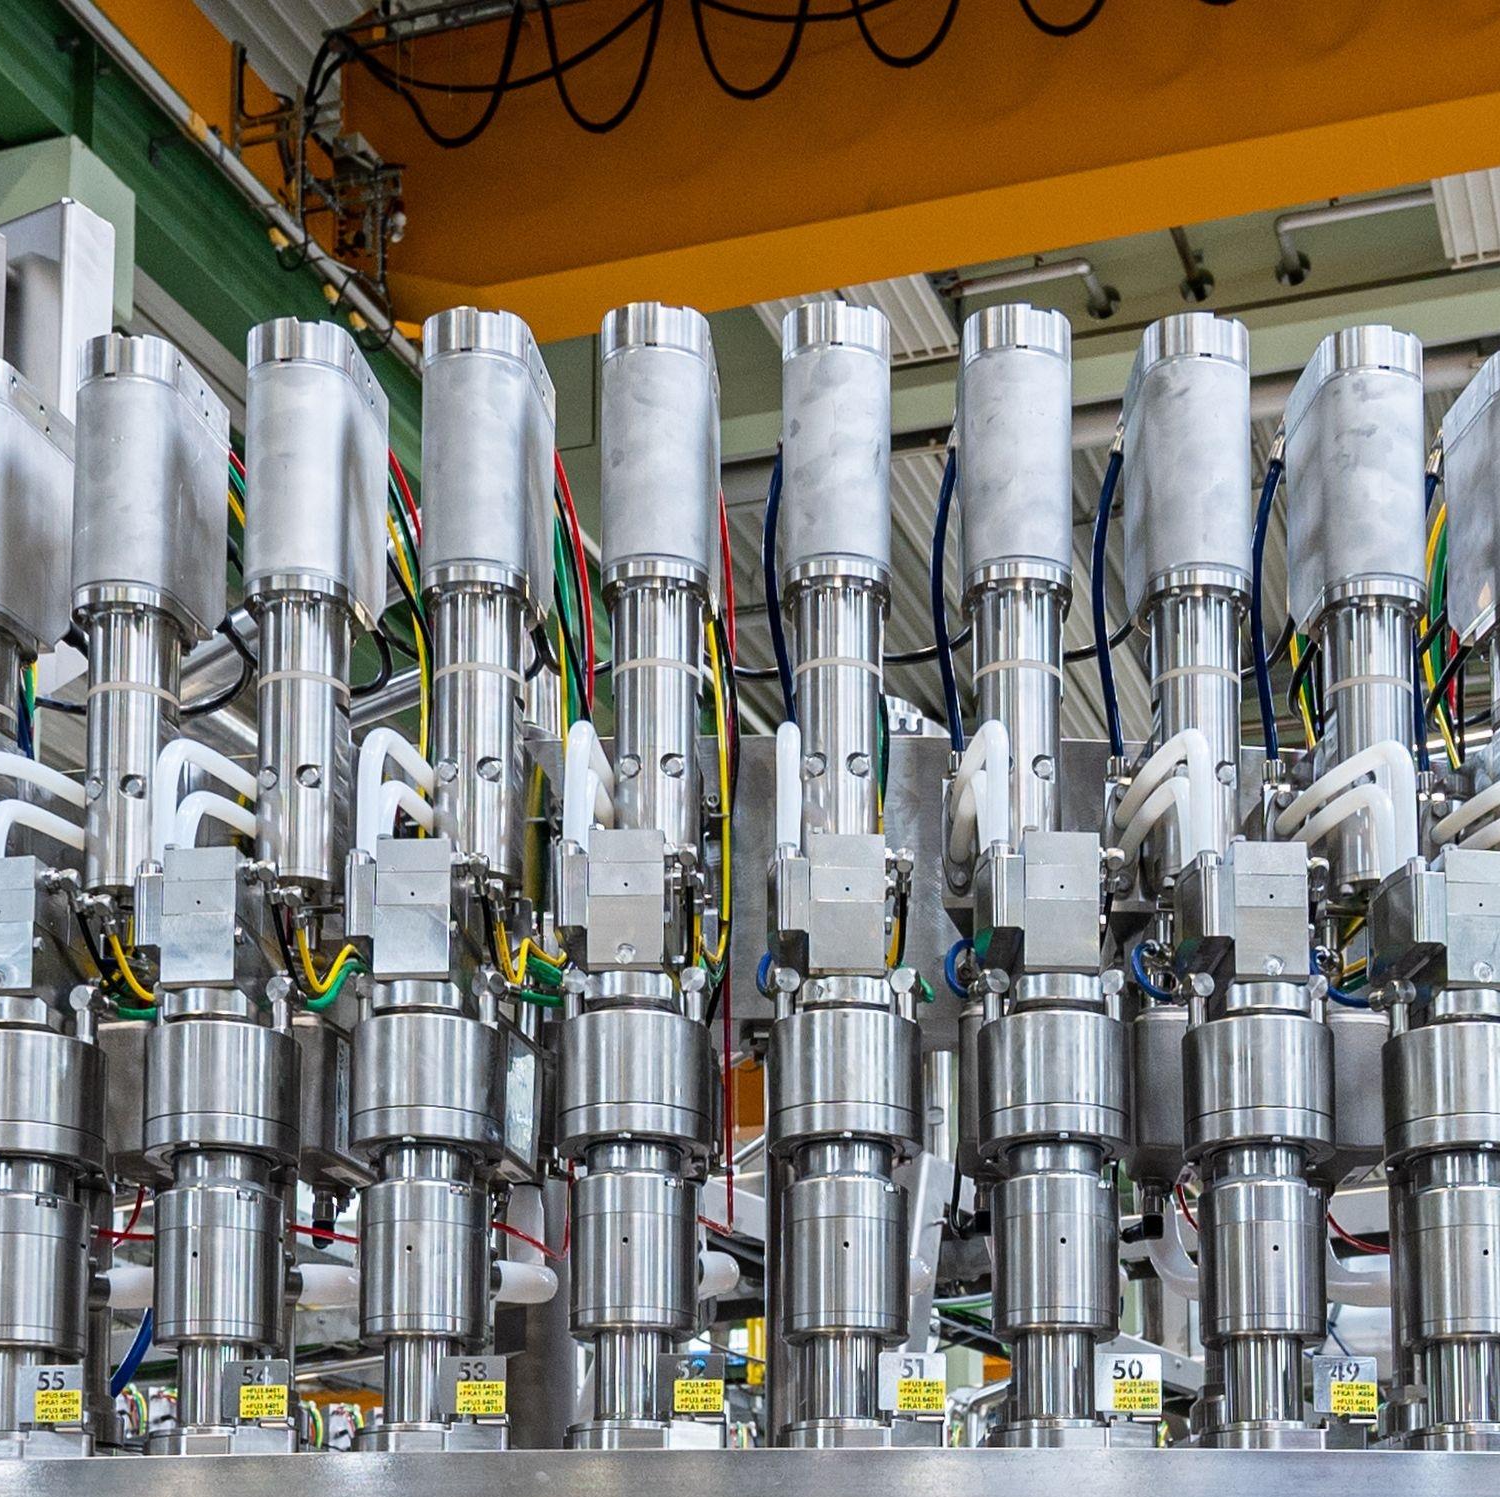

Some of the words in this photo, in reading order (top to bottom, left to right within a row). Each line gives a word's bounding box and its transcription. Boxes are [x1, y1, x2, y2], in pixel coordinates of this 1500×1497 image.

[242, 1366, 273, 1386] 54
[458, 1362, 487, 1381] 53
[900, 1359, 924, 1378] 51
[1113, 1360, 1142, 1380] 50
[1331, 1362, 1360, 1381] 49
[37, 1371, 64, 1390] 55
